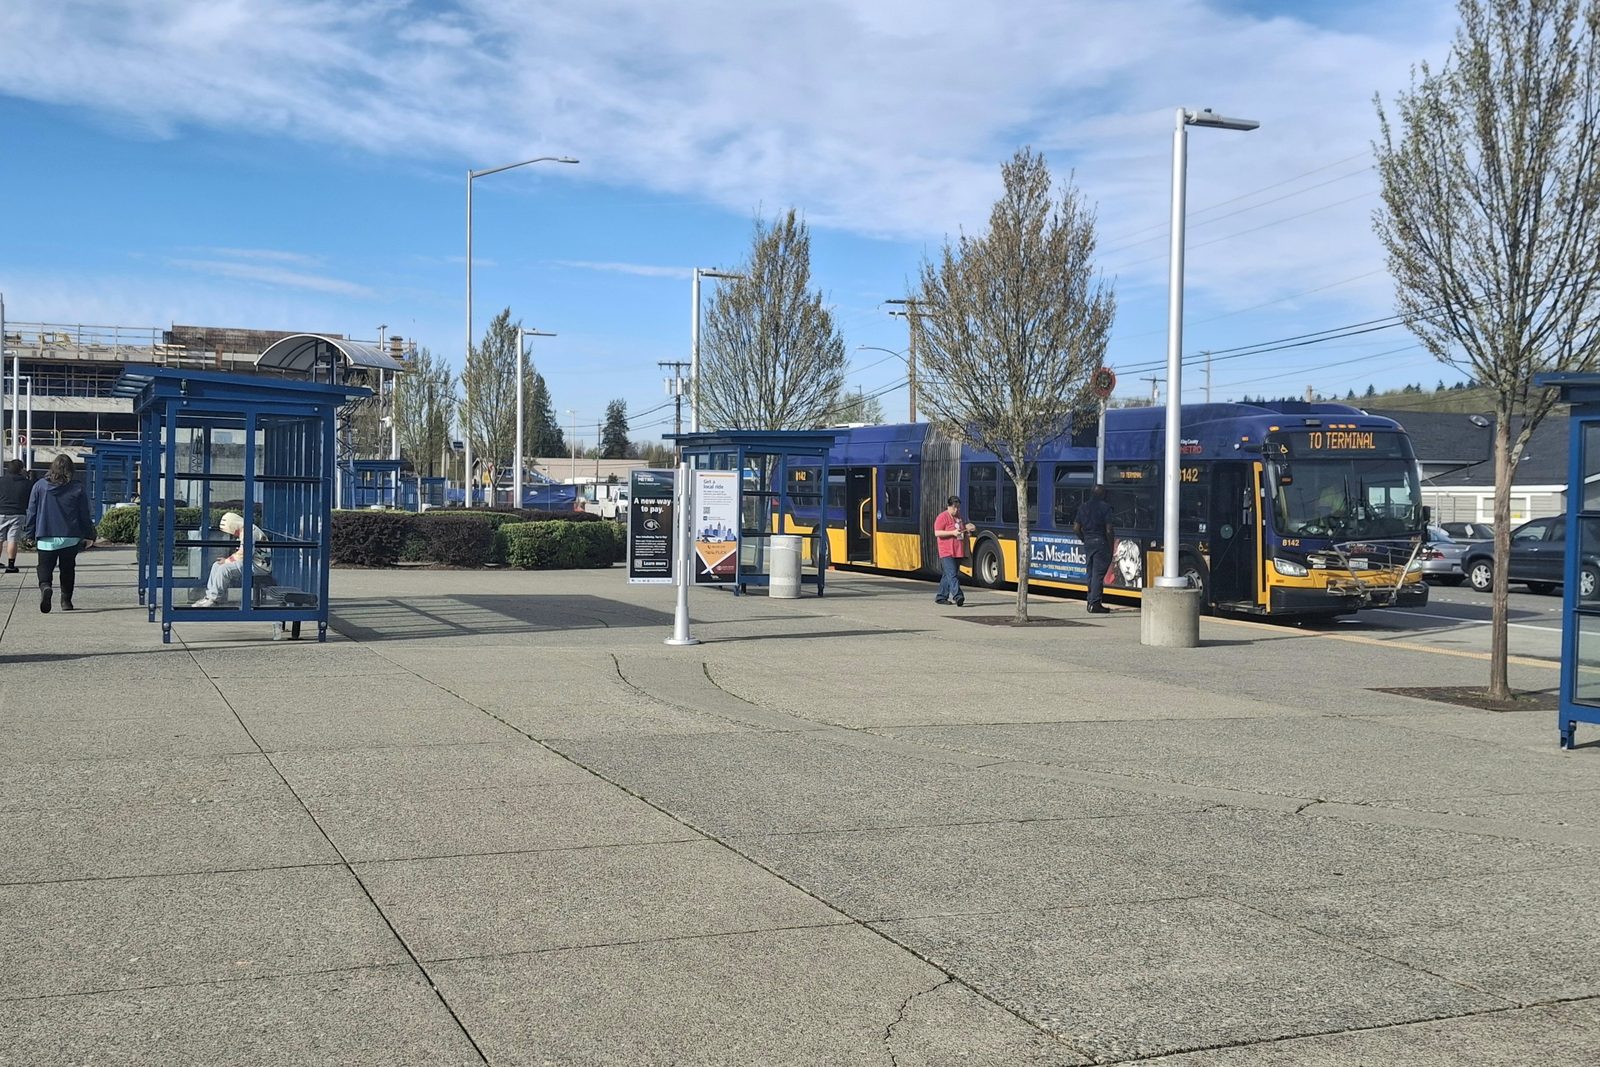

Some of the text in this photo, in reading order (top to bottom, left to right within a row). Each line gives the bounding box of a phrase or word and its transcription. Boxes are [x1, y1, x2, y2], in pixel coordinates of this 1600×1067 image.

[1309, 432, 1376, 449] TO TERMINAL
[633, 497, 640, 505] A
[641, 505, 664, 514] to pay.
[1031, 544, 1087, 565] Les Misérables
